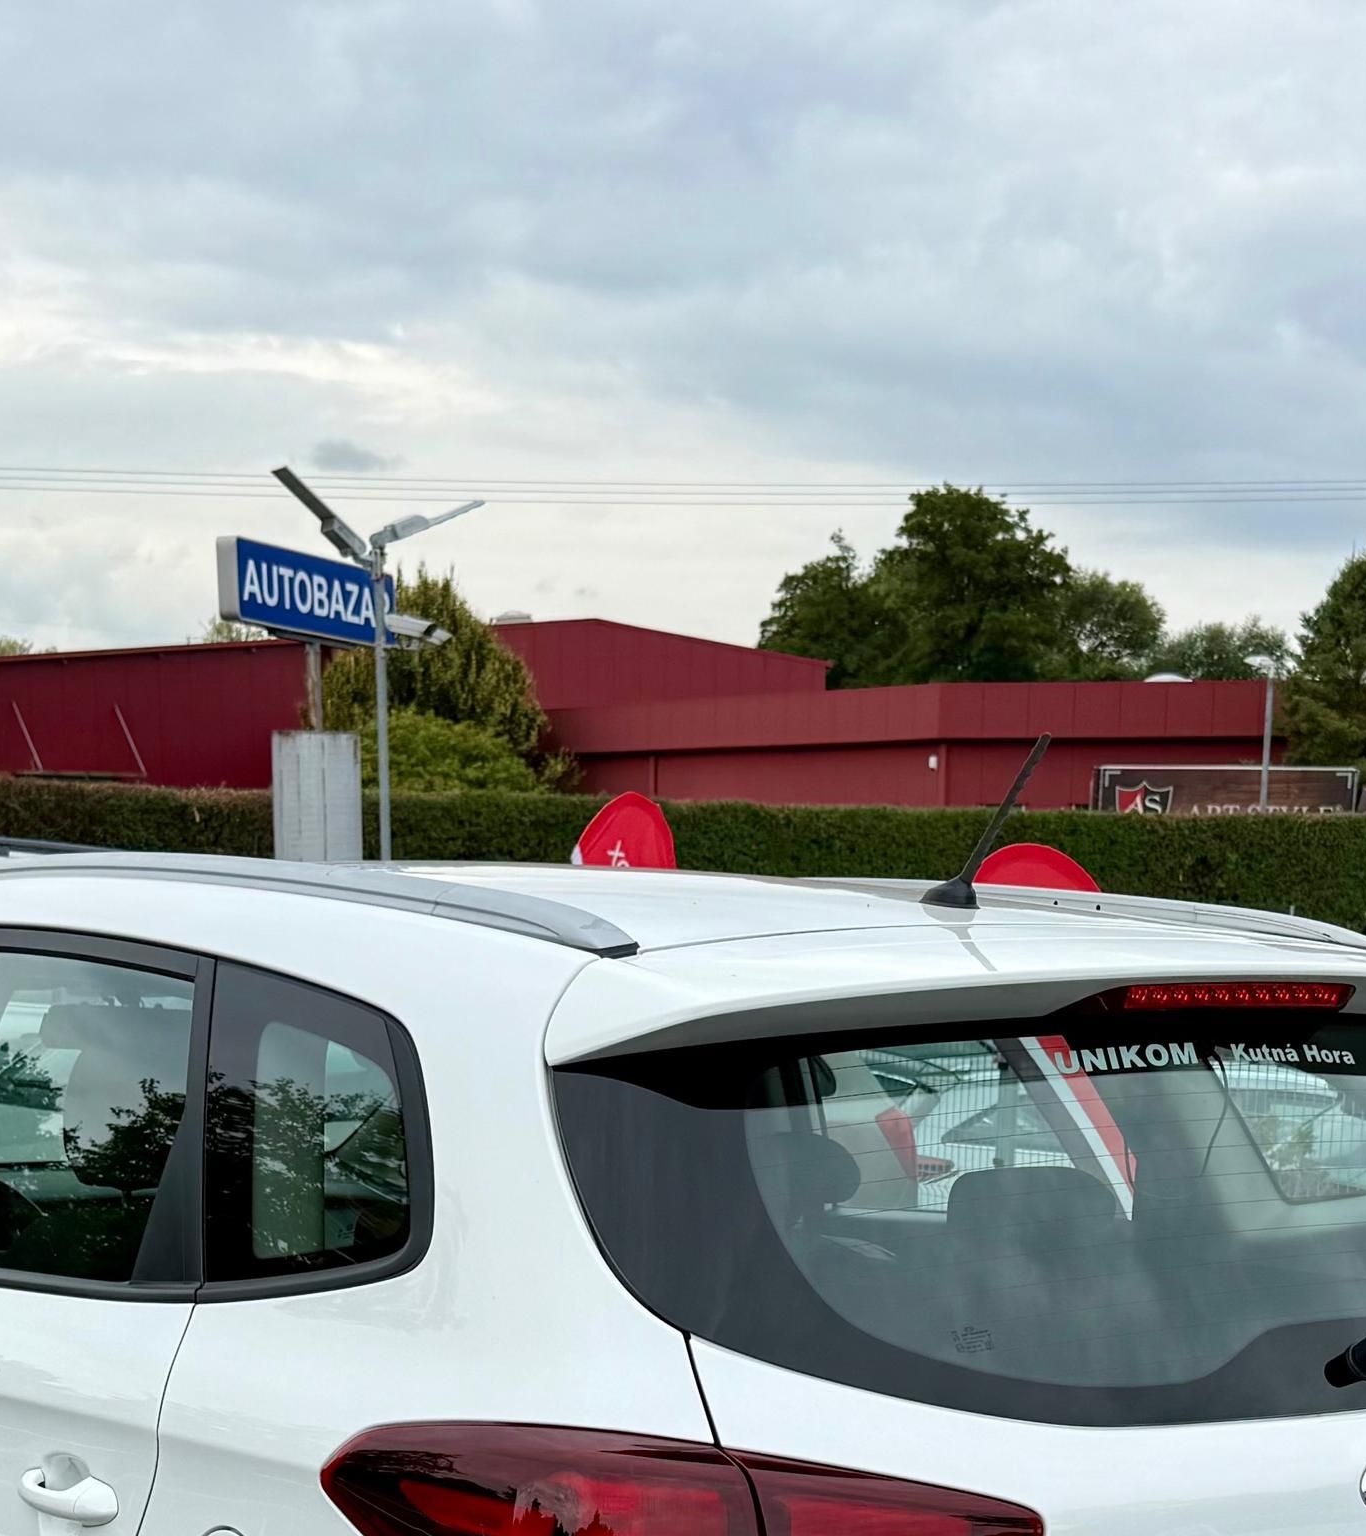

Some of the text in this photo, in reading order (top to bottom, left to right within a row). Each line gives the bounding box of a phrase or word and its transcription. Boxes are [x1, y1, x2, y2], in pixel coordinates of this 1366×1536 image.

[1054, 1042, 1356, 1074] UNIKOM Kutná Hora
